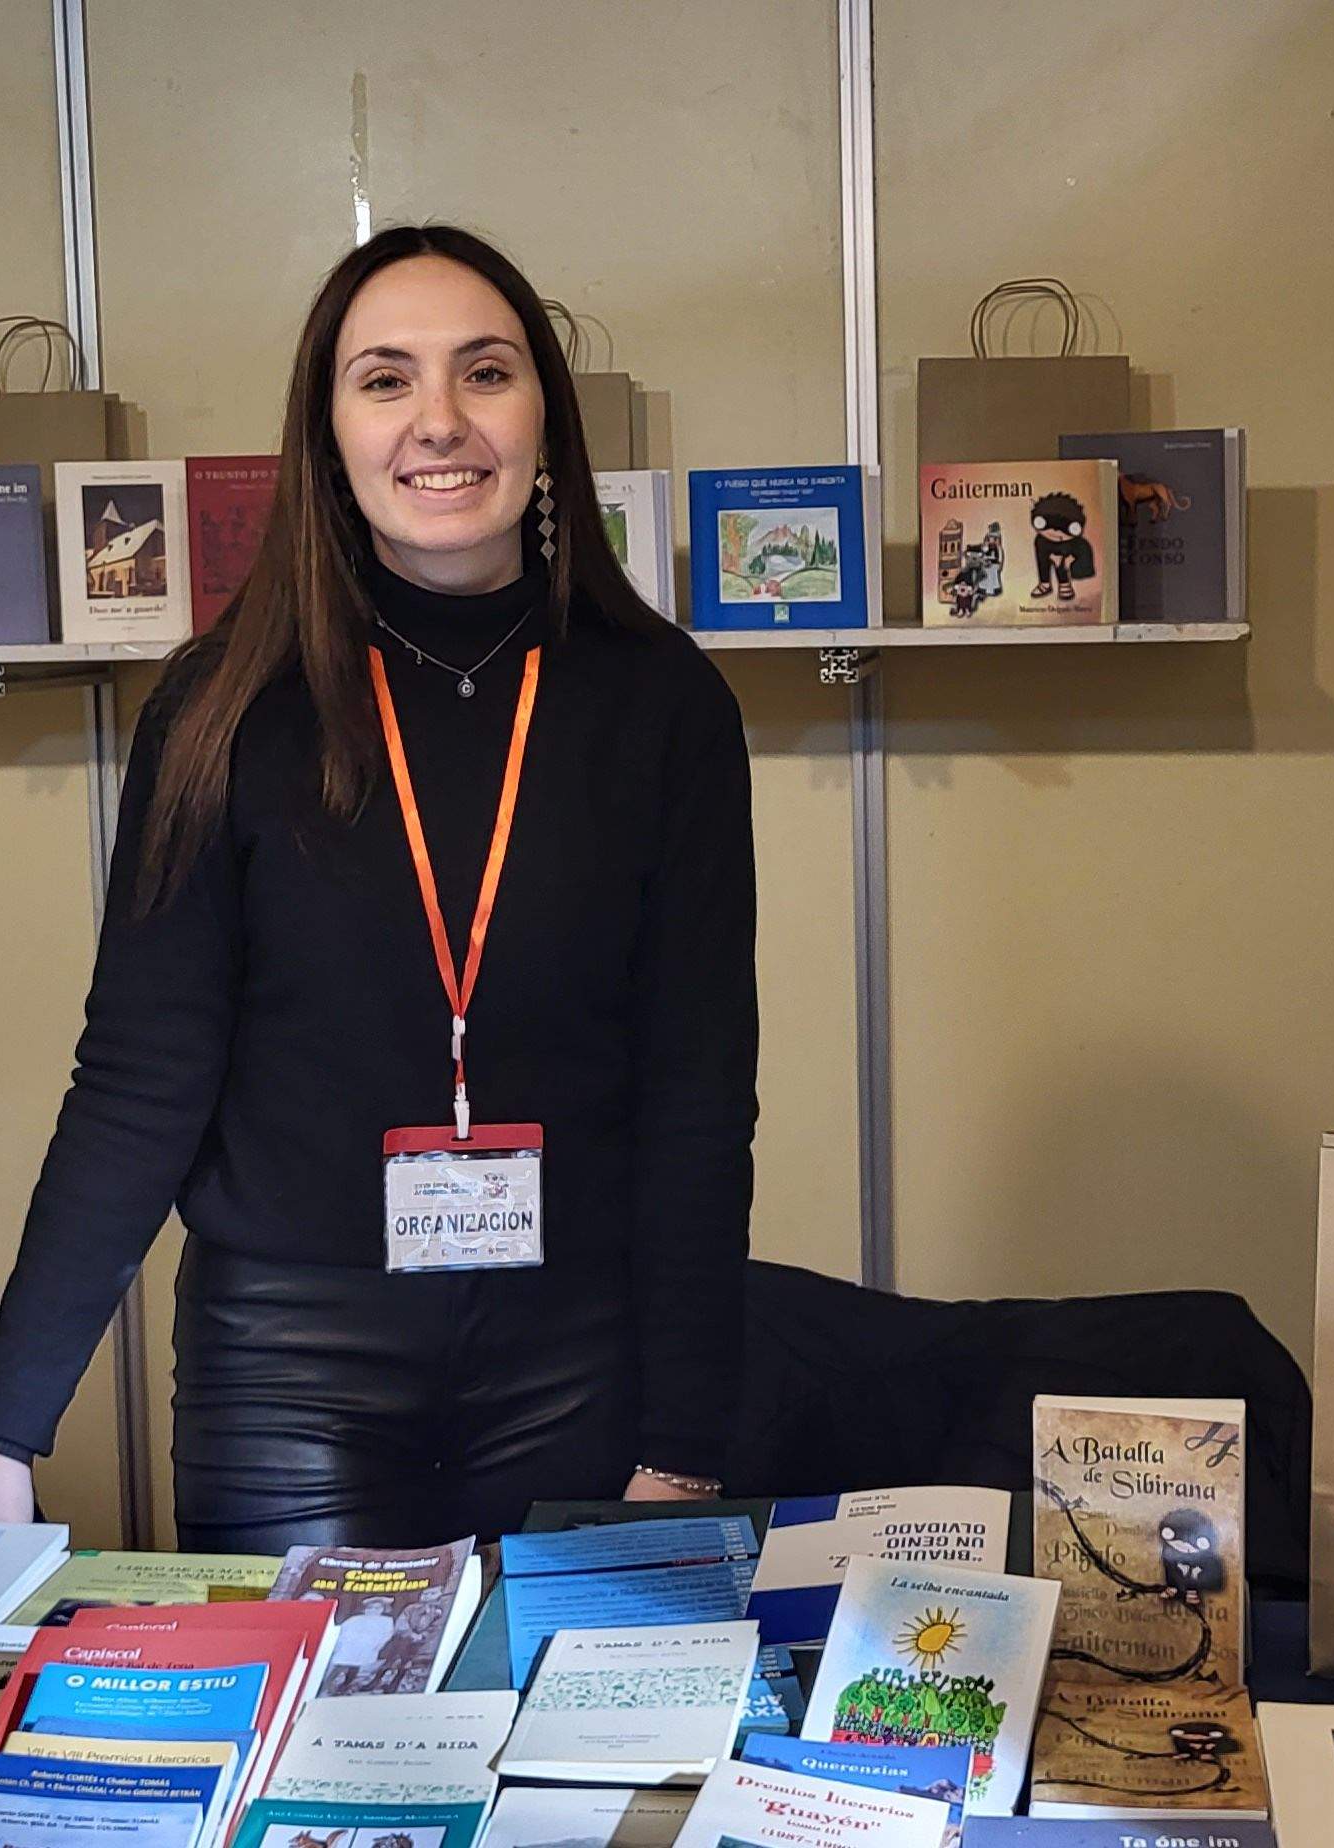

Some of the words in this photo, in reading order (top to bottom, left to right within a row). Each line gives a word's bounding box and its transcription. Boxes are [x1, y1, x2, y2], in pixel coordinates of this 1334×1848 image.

[931, 478, 1033, 500] Gaiterman
[1041, 1436, 1069, 1465] A
[1073, 1436, 1164, 1469] Batalla
[1083, 1466, 1103, 1484] de
[1110, 1470, 1216, 1502] Sibirana
[886, 1536, 949, 1549] GENIO
[956, 1537, 984, 1548] UN
[890, 1576, 907, 1588] La
[910, 1579, 942, 1593] selba
[944, 1586, 1010, 1602] encantada
[64, 1647, 142, 1661] Capiscol
[66, 1674, 86, 1688] O
[91, 1676, 172, 1692] MILLOR
[178, 1674, 238, 1692] ESTIU
[334, 1739, 385, 1750] TAMAS
[436, 1740, 478, 1750] BIDA
[87, 1750, 143, 1763] Premios
[147, 1750, 211, 1764] Literarios
[801, 1756, 909, 1777] Querenzias
[735, 1775, 817, 1800] Premios
[825, 1790, 915, 1819] literarios
[1119, 1835, 1147, 1848] Ta
[1208, 1835, 1240, 1848] im
